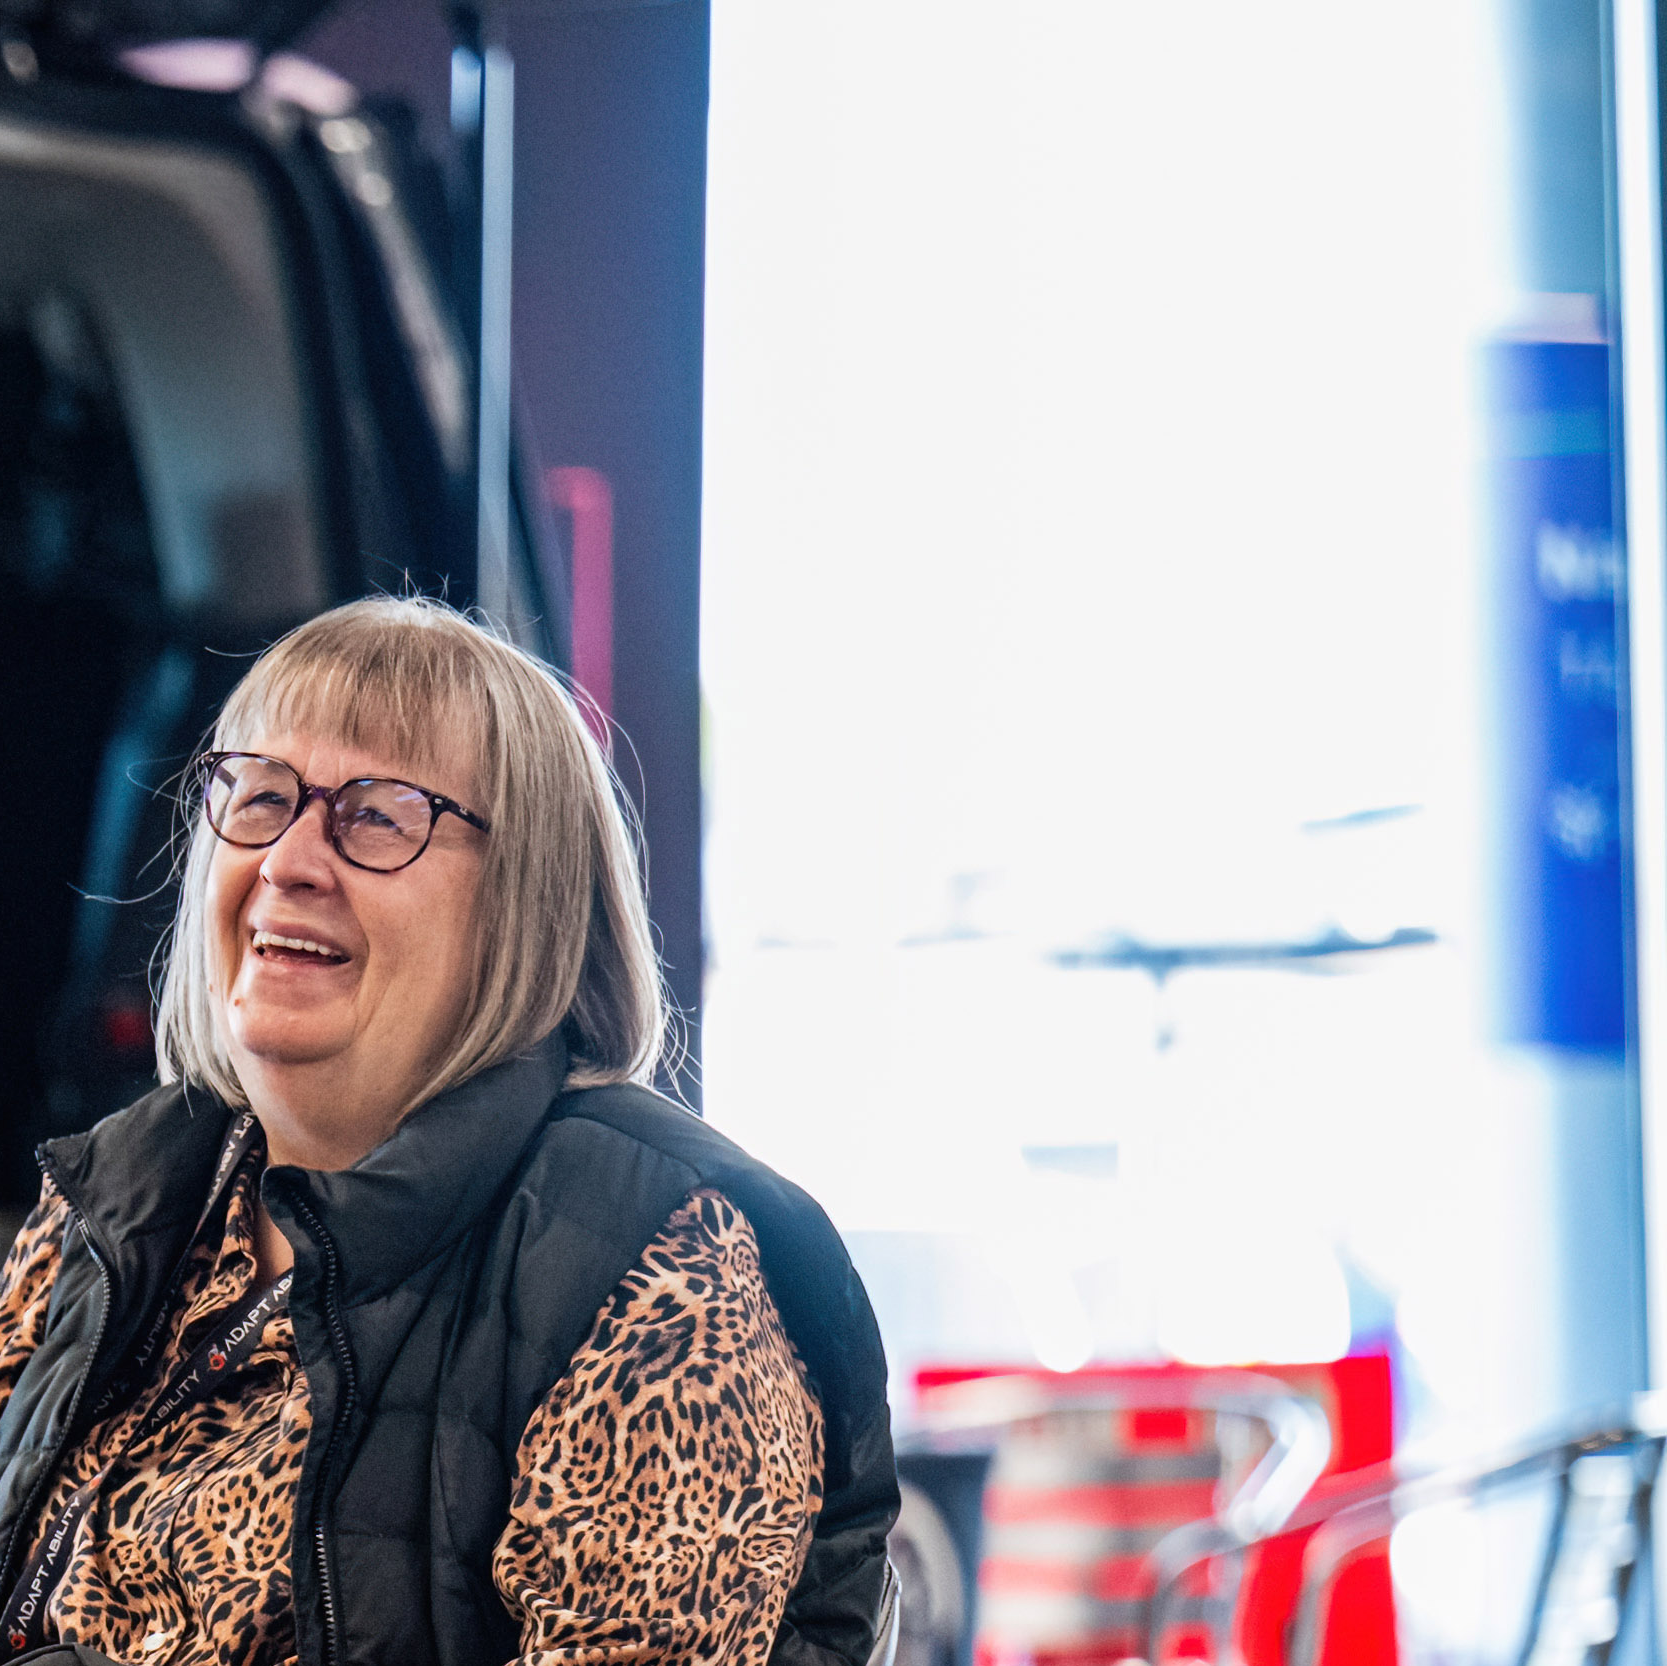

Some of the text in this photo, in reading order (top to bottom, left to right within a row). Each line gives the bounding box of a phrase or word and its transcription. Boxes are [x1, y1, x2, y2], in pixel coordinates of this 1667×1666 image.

[151, 1297, 271, 1428] ABILITY ADAPT
[17, 1495, 81, 1629] ADAPT ABILITY
